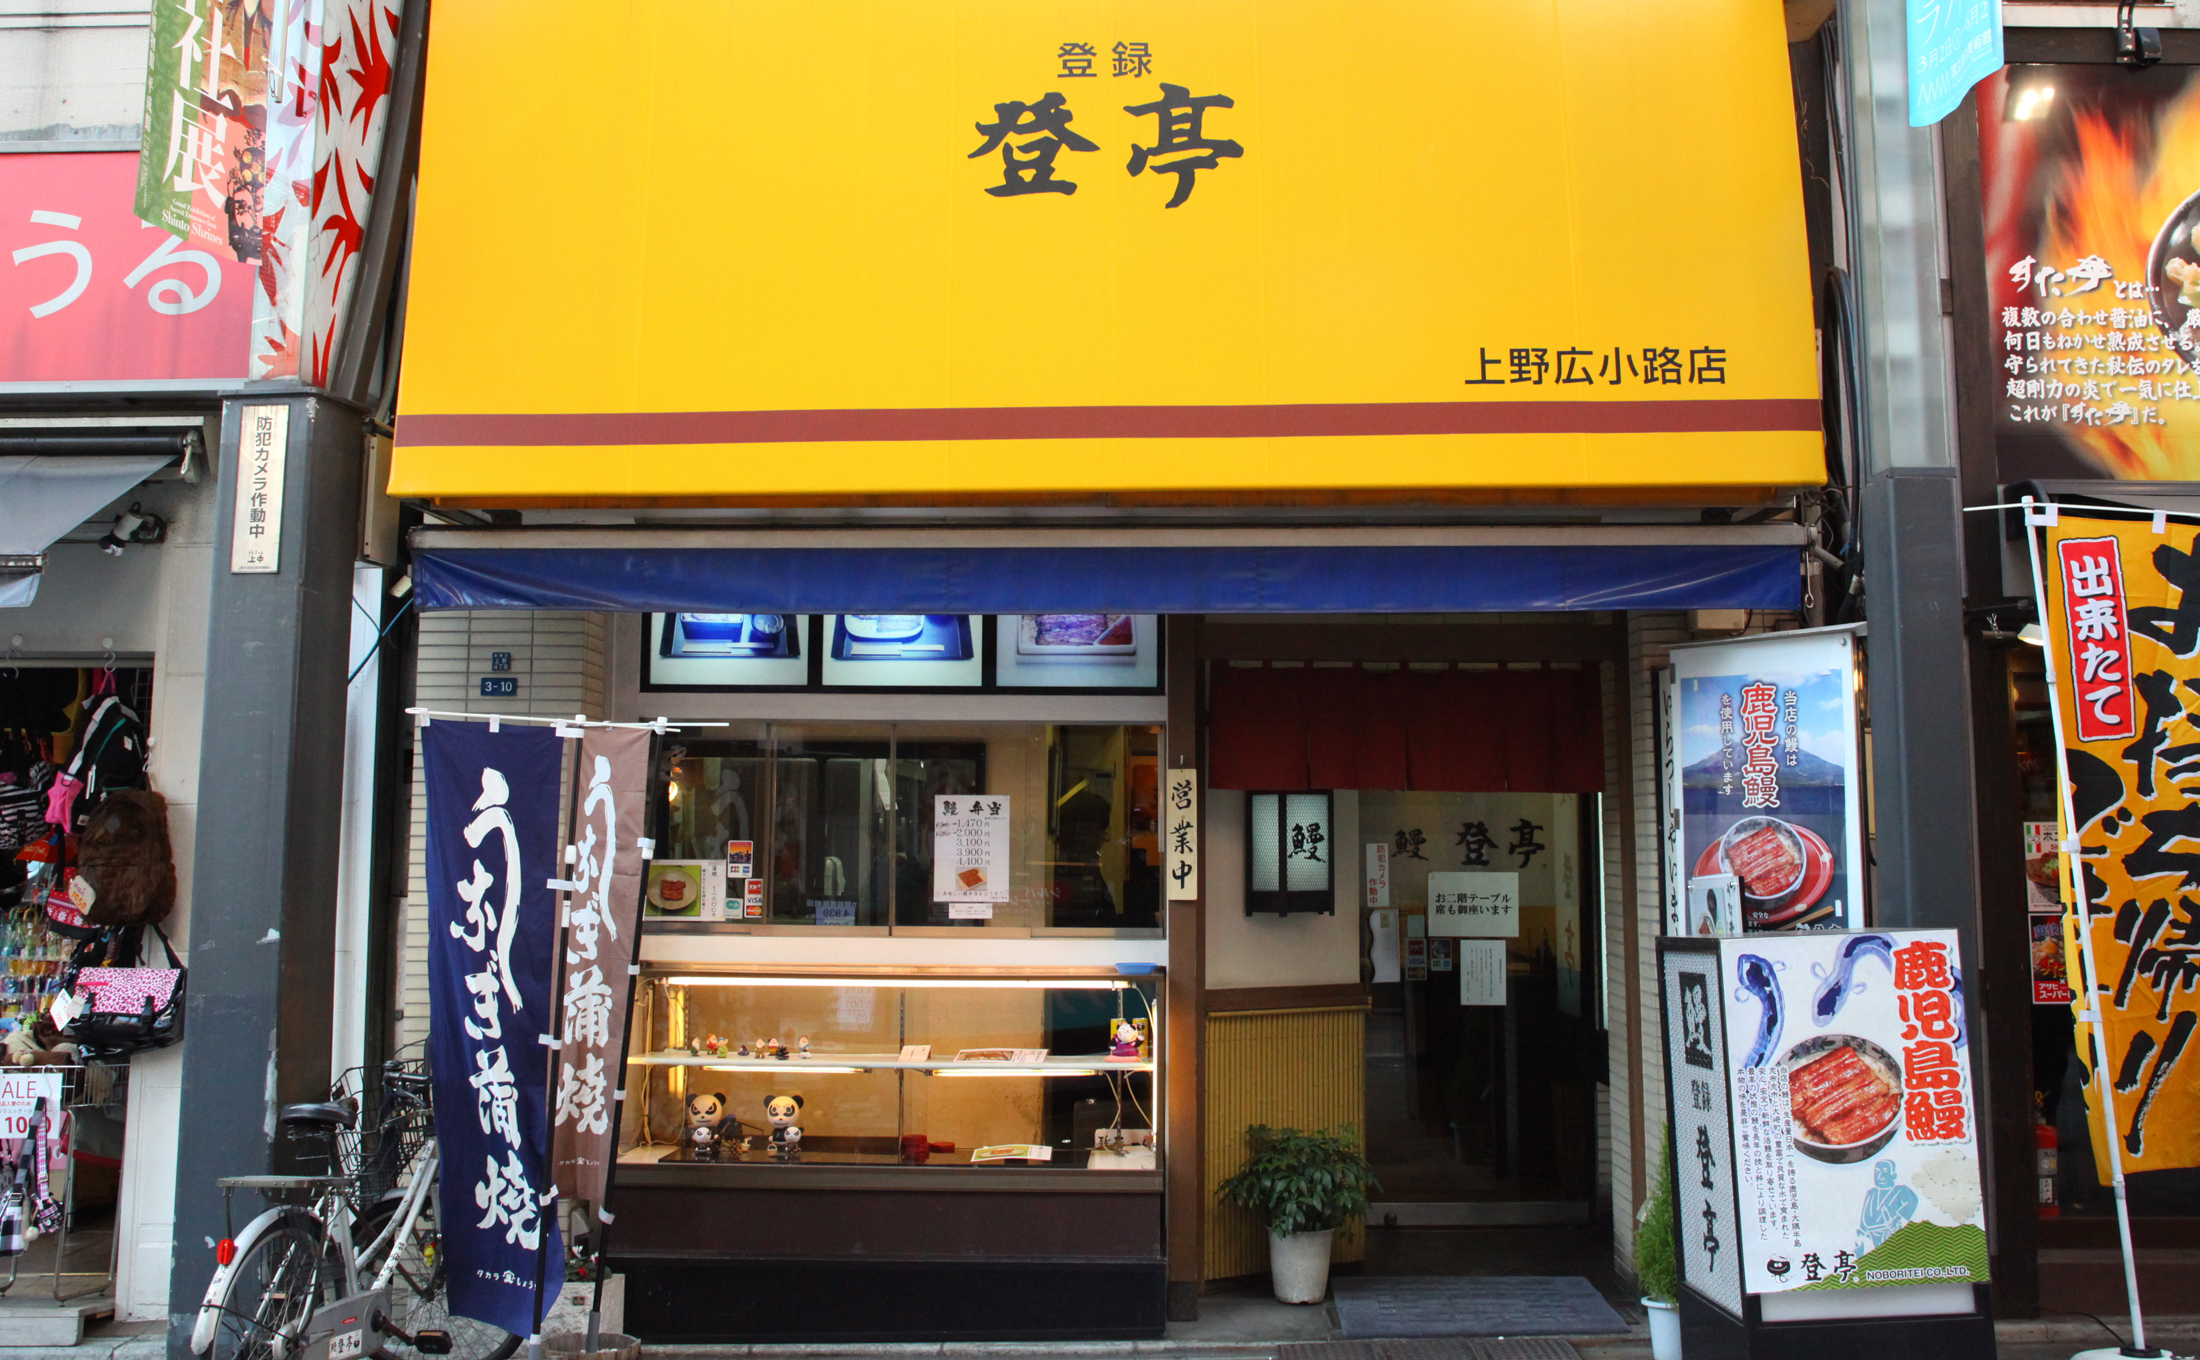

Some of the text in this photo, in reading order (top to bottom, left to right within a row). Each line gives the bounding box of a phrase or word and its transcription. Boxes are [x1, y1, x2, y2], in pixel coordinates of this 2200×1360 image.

[1057, 41, 1152, 78] 登録
[967, 82, 1244, 209] 登亭
[162, 209, 223, 246] Shinto Shrines
[12, 209, 222, 320] うる
[1464, 345, 1727, 385] 上野広小路店
[249, 416, 273, 539] 防犯カメラ作動中
[2070, 555, 2122, 725] 出来たて
[485, 681, 513, 692] 3-10
[1720, 694, 1734, 795] を使用しています
[1742, 681, 1780, 807] 鹿児島鰻
[1784, 690, 1799, 766] 当店の鰻は
[1170, 779, 1194, 890] 営業中
[1288, 822, 1326, 863] 鰻
[1391, 817, 1545, 869] 鰻 登亭
[1377, 845, 1387, 889] 防犯カメラ
[1369, 878, 1378, 905] 作動中
[1435, 893, 1512, 904] お二階テーブル
[1435, 904, 1512, 915] 席も御座います
[2039, 983, 2058, 991] アサヒ
[1892, 939, 1970, 1143] 鹿児島鰻
[0, 1080, 37, 1099] ALE
[1695, 1124, 1720, 1273] 登亭
[1800, 1249, 1858, 1283] 登亭
[1866, 1269, 1924, 1281] NOBORITEI
